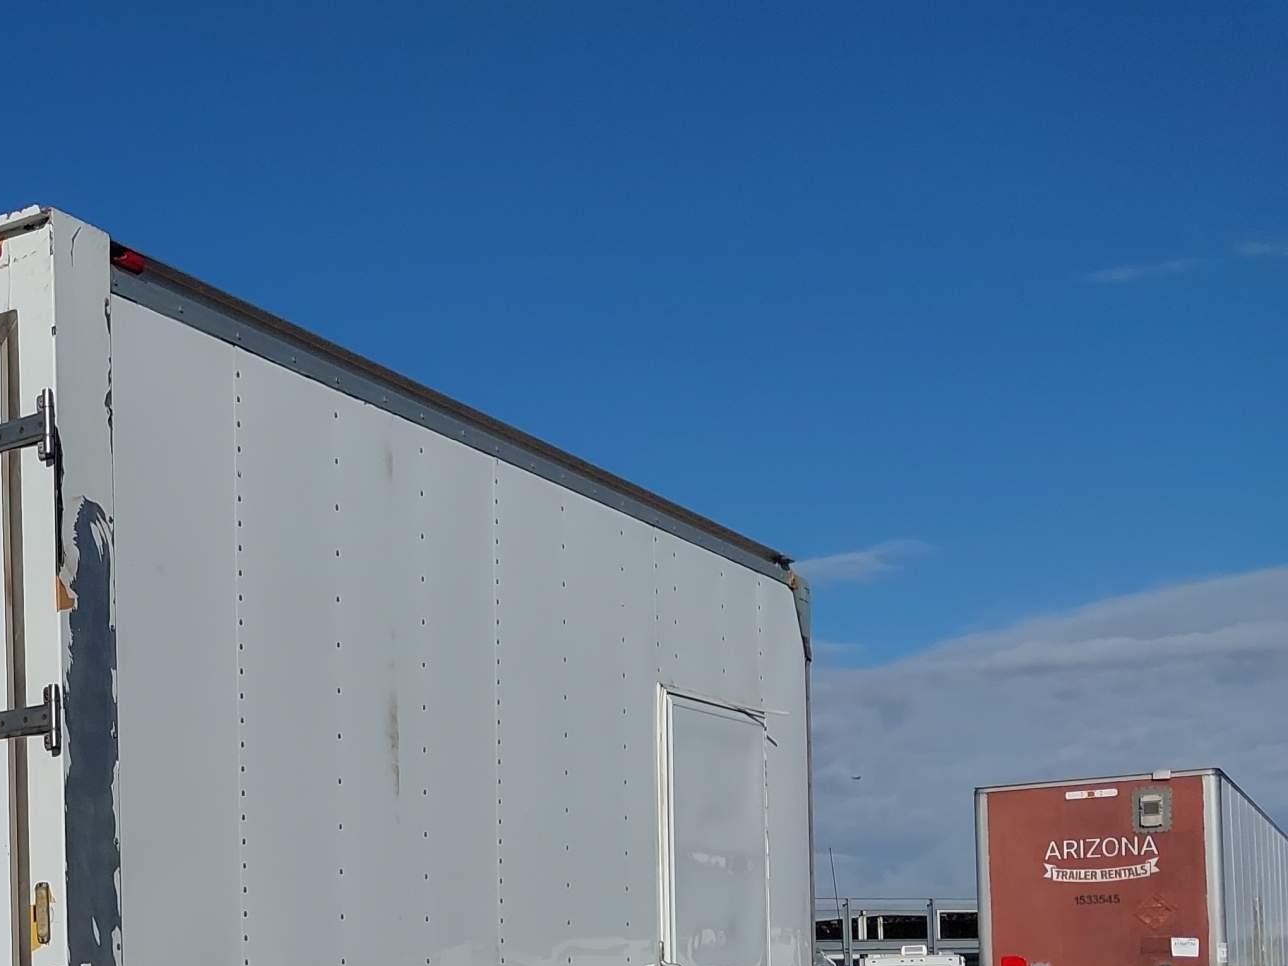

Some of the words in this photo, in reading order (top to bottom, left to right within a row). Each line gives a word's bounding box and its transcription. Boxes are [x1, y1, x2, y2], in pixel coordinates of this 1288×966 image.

[1044, 835, 1159, 860] ARIZONA
[1055, 869, 1098, 881] TRAILER
[1100, 865, 1148, 880] RENTALS
[1074, 894, 1121, 905] 1533545
